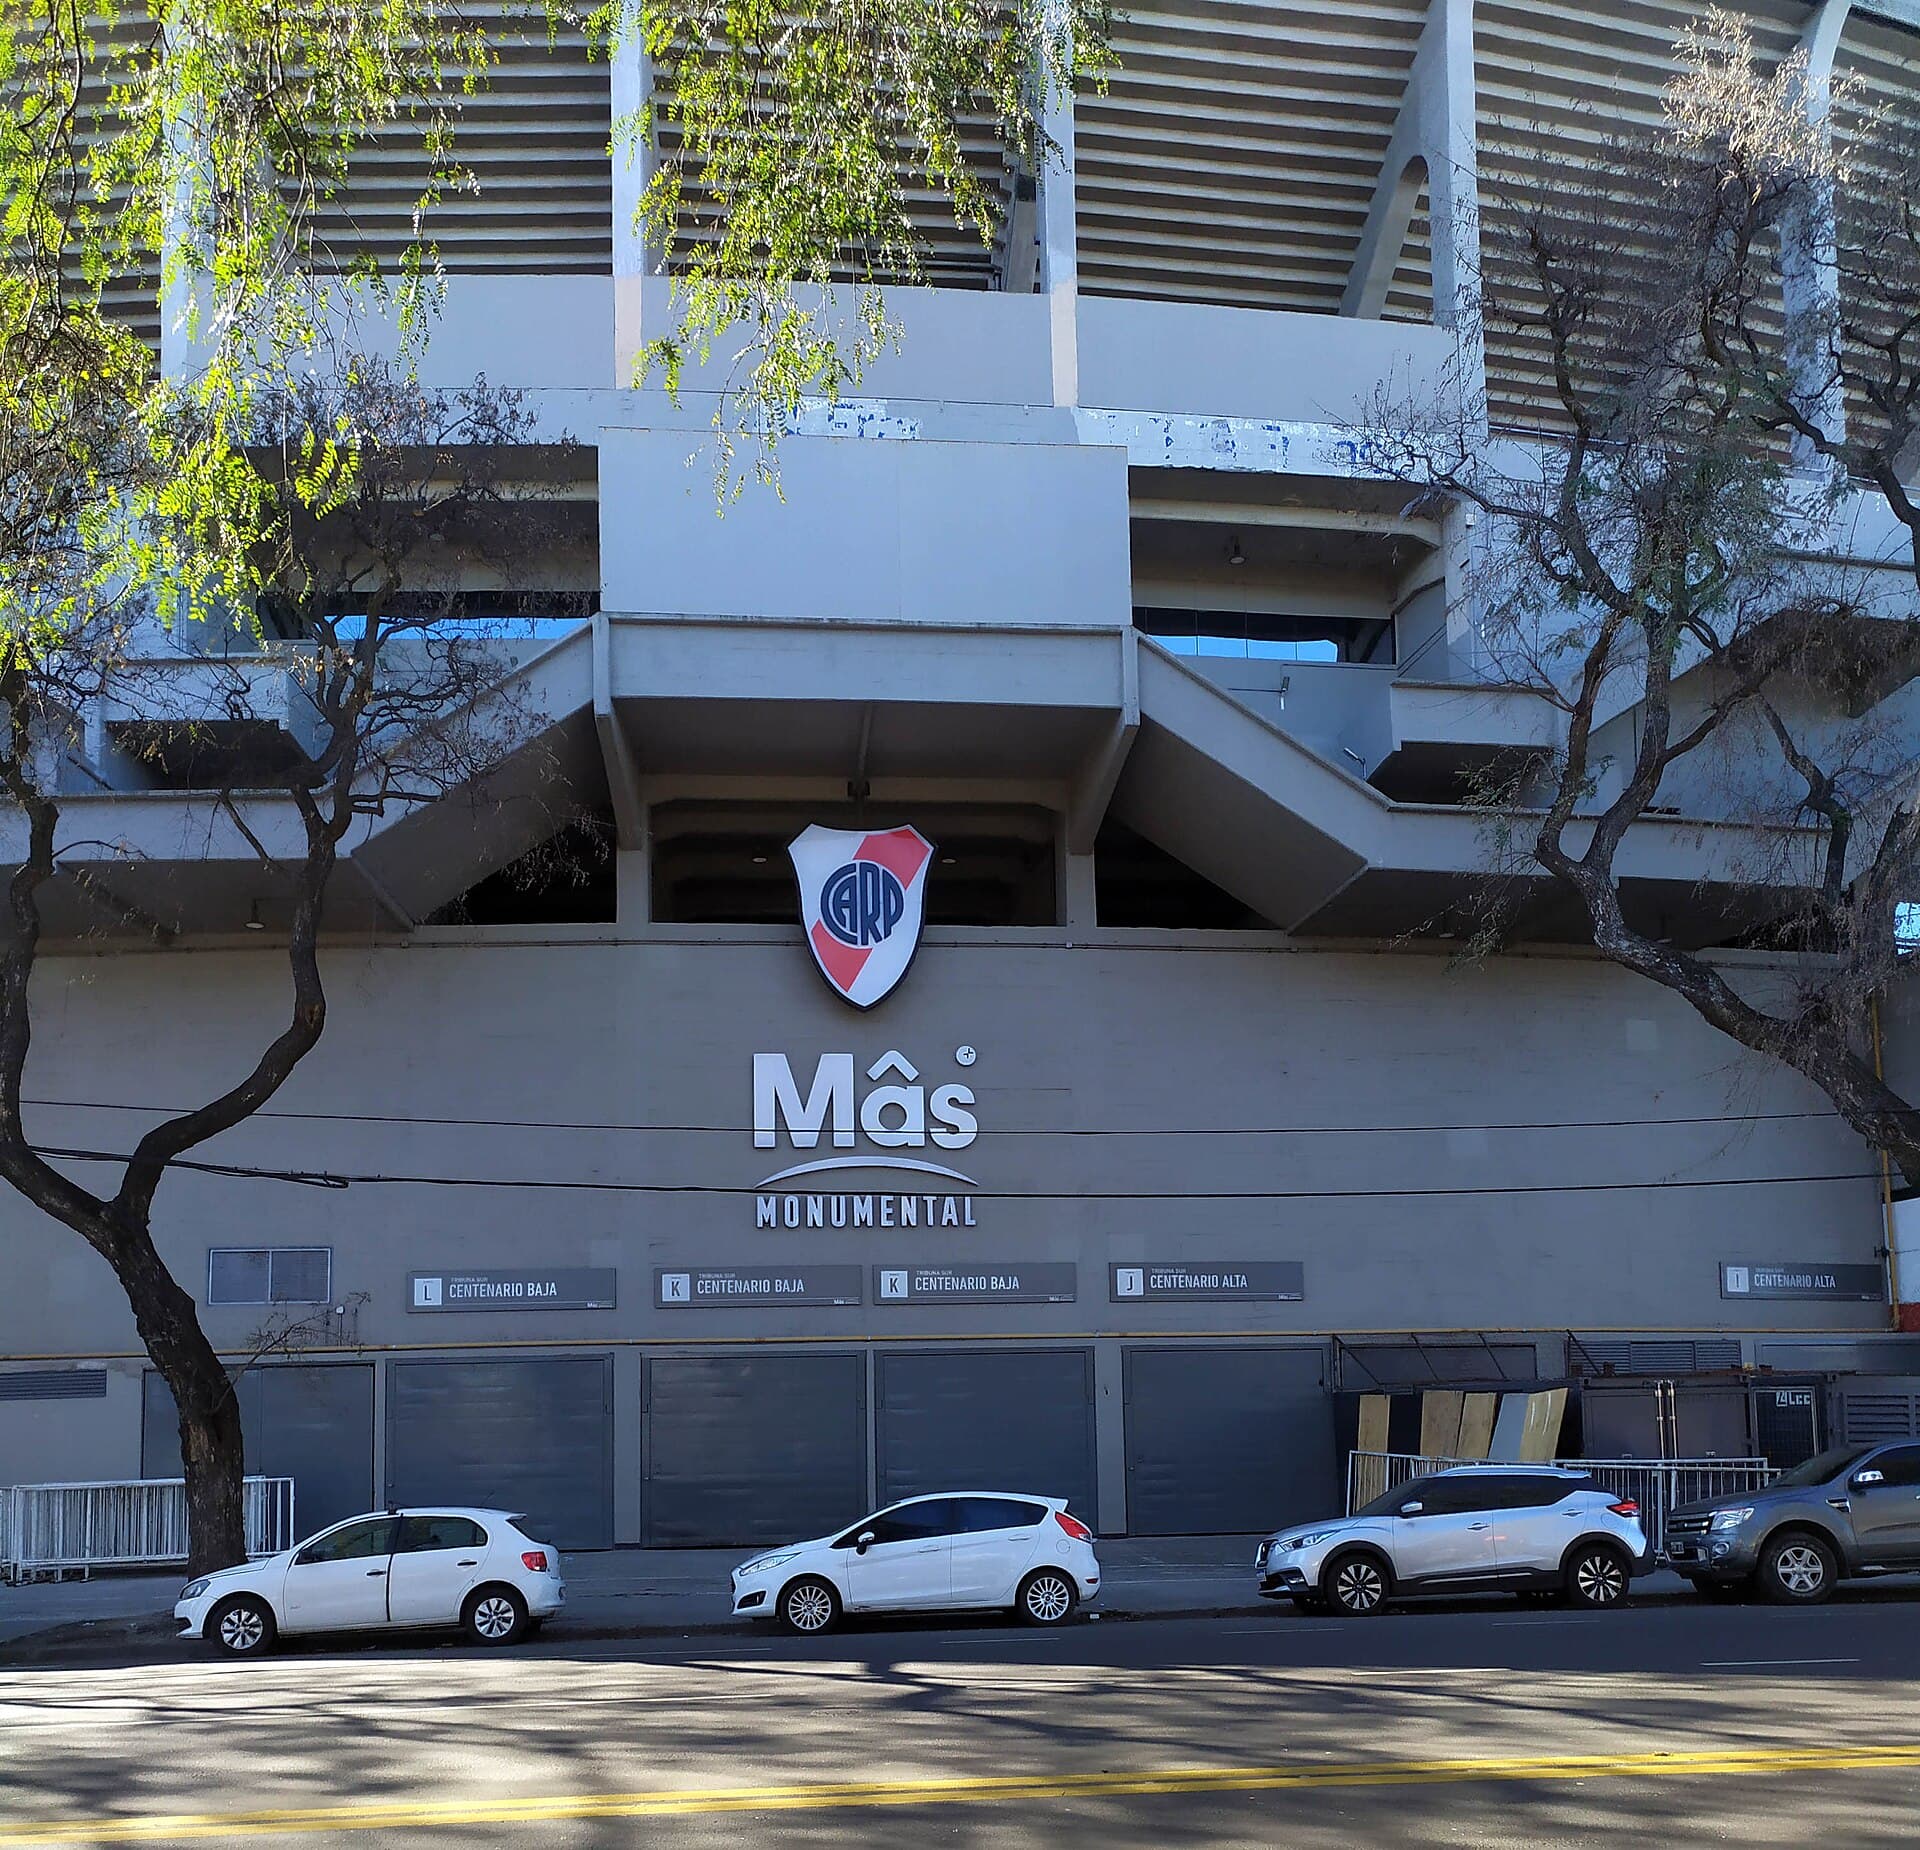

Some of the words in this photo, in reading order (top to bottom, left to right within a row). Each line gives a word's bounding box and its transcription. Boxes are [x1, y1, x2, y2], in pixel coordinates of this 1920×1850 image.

[820, 861, 905, 946] CARP
[756, 1195, 977, 1228] MONUMENTAL
[671, 1279, 681, 1297] K
[697, 1279, 771, 1294] CENTENARIO
[775, 1279, 805, 1293] BAJA
[889, 1277, 899, 1293] K
[915, 1277, 986, 1291] CENTENARIO
[991, 1276, 1020, 1290] BAJA
[1126, 1275, 1133, 1291] J
[1150, 1275, 1219, 1289] CENTENARIO
[1222, 1274, 1248, 1288] ALTA
[1754, 1274, 1812, 1288] CENTENARIO
[1815, 1274, 1837, 1288] ALTA
[424, 1284, 432, 1301] L
[450, 1283, 523, 1298] CENTENARIO
[527, 1282, 557, 1297] BAJA
